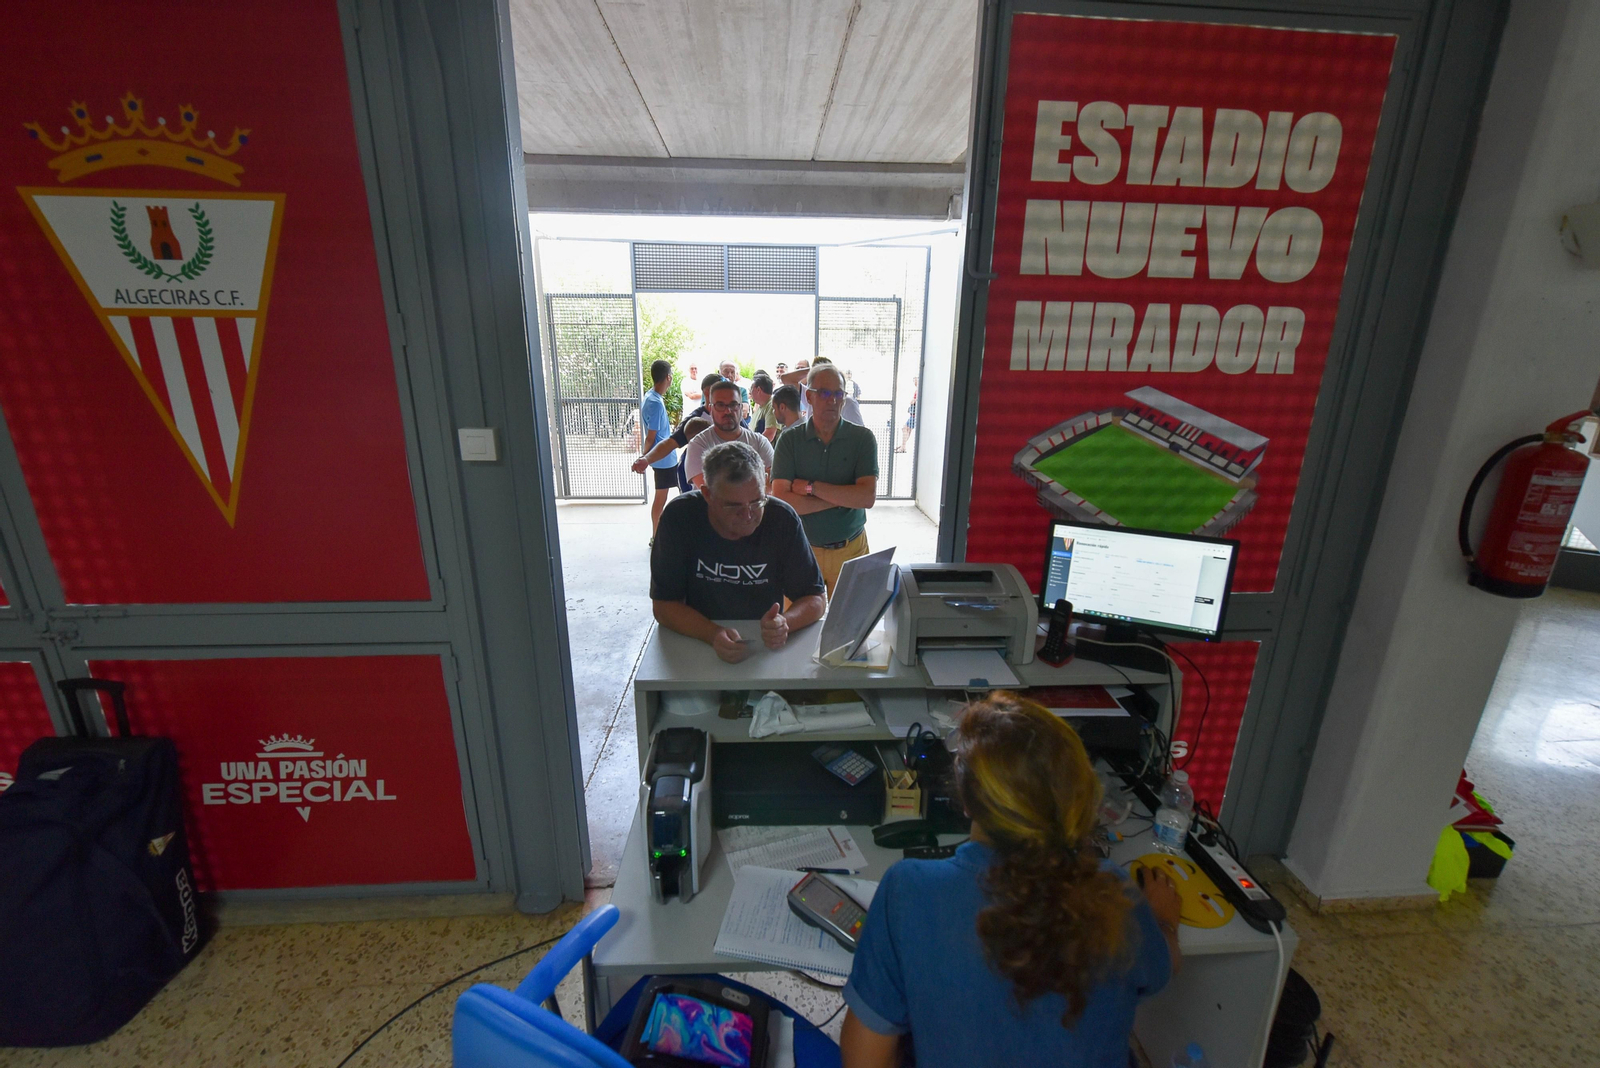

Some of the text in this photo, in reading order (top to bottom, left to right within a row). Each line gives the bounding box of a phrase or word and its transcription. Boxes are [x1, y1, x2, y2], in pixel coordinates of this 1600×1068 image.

[1031, 99, 1343, 194] ESTADIO
[1019, 199, 1324, 284] NUEVO
[114, 288, 244, 306] ALGECIRAS C.F.
[1009, 300, 1306, 375] MIRADOR
[697, 558, 768, 579] NOW
[202, 779, 397, 805] ESPECIAL
[220, 753, 367, 781] UNA PASIÓN
[176, 867, 198, 954] Kappa
